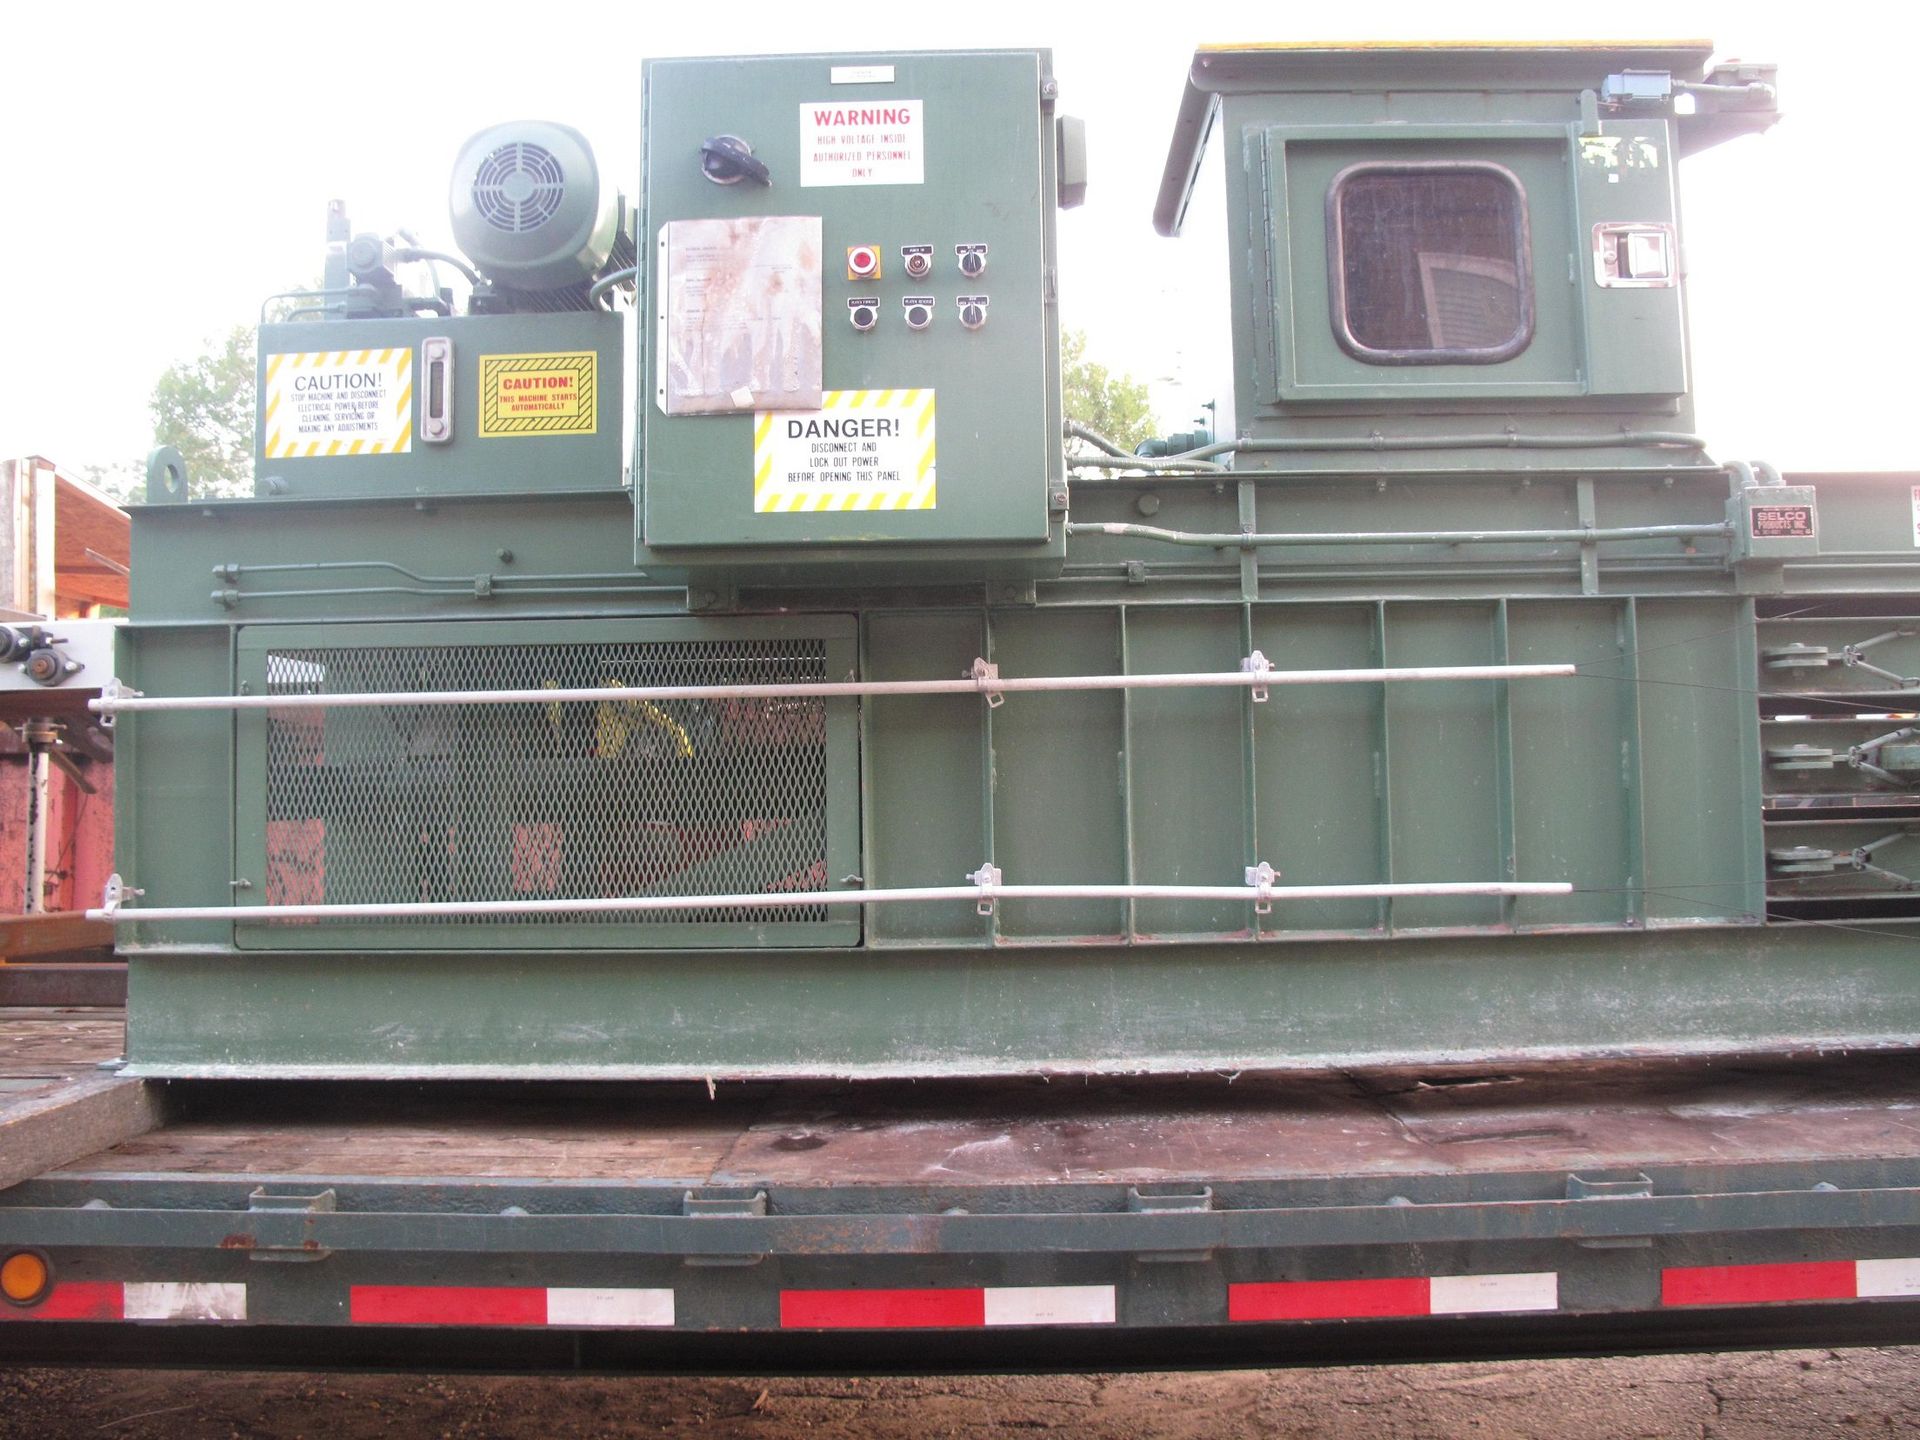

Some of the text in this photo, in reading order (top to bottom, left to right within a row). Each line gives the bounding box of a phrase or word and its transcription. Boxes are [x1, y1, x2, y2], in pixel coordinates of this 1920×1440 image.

[814, 108, 911, 126] WARNING
[817, 133, 906, 145] HIGH VOLTAGE INSIDE
[813, 150, 911, 162] AUTHORIZED PERSONNEL
[852, 168, 873, 178] ONLY
[295, 372, 382, 391] CAUTION!
[503, 376, 573, 390] CAUTION!
[291, 389, 386, 402] STOP MACHINE AND DISCONNECT
[500, 392, 578, 403] THIS MACHINE STARTS
[298, 400, 379, 412] ELECTRICAL POWER BEFORE
[511, 403, 565, 412] AUTOMATICALLY
[334, 412, 364, 421] SERVICING
[367, 411, 375, 420] OR
[299, 421, 378, 433] MAKING ANY ADJUSTMENTS
[788, 418, 900, 438] DANGER!
[811, 442, 877, 453] DISCONNECT AND
[809, 456, 879, 468] LOCK OUT POWER
[787, 470, 901, 483] BEFORE OPENING THIS PANEL
[1757, 511, 1806, 521] SELCO
